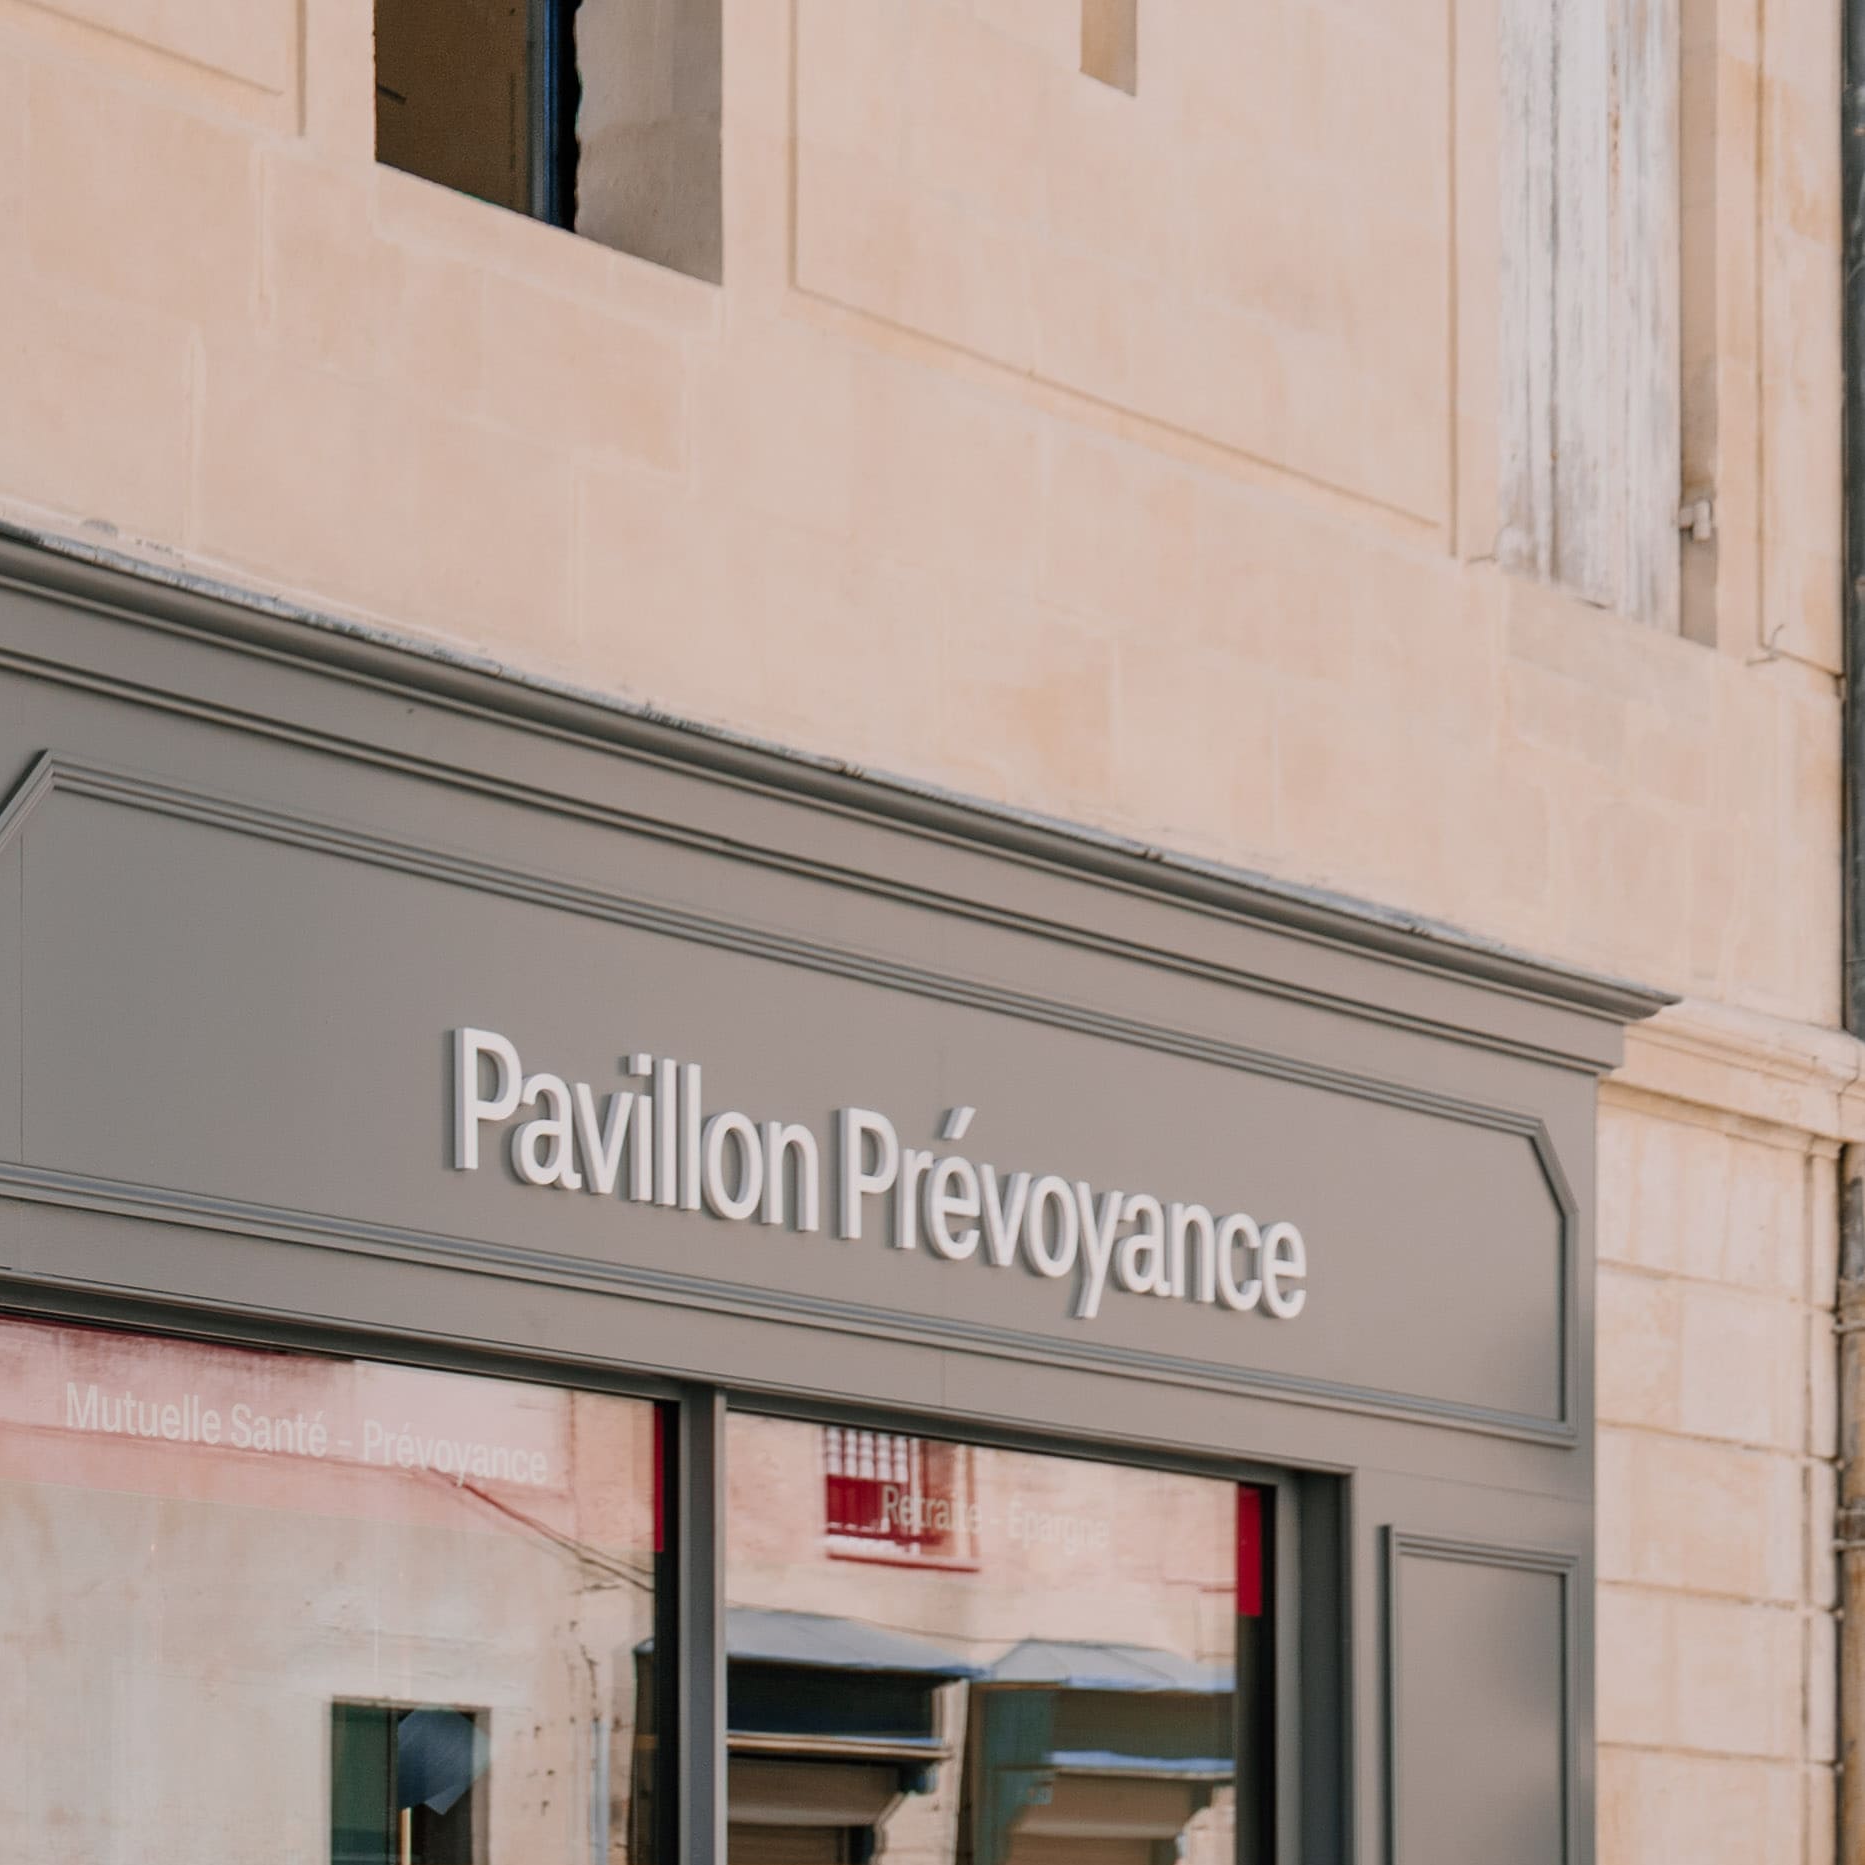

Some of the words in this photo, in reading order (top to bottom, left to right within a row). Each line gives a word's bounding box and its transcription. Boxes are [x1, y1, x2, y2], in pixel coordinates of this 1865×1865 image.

[454, 1026, 820, 1234] Pavillon
[838, 1105, 1308, 1320] Prévoyance
[66, 1381, 221, 1446] Mutuelle
[230, 1402, 327, 1458] Santé
[363, 1419, 548, 1488] Prévoyance
[881, 1483, 983, 1536] Retraite
